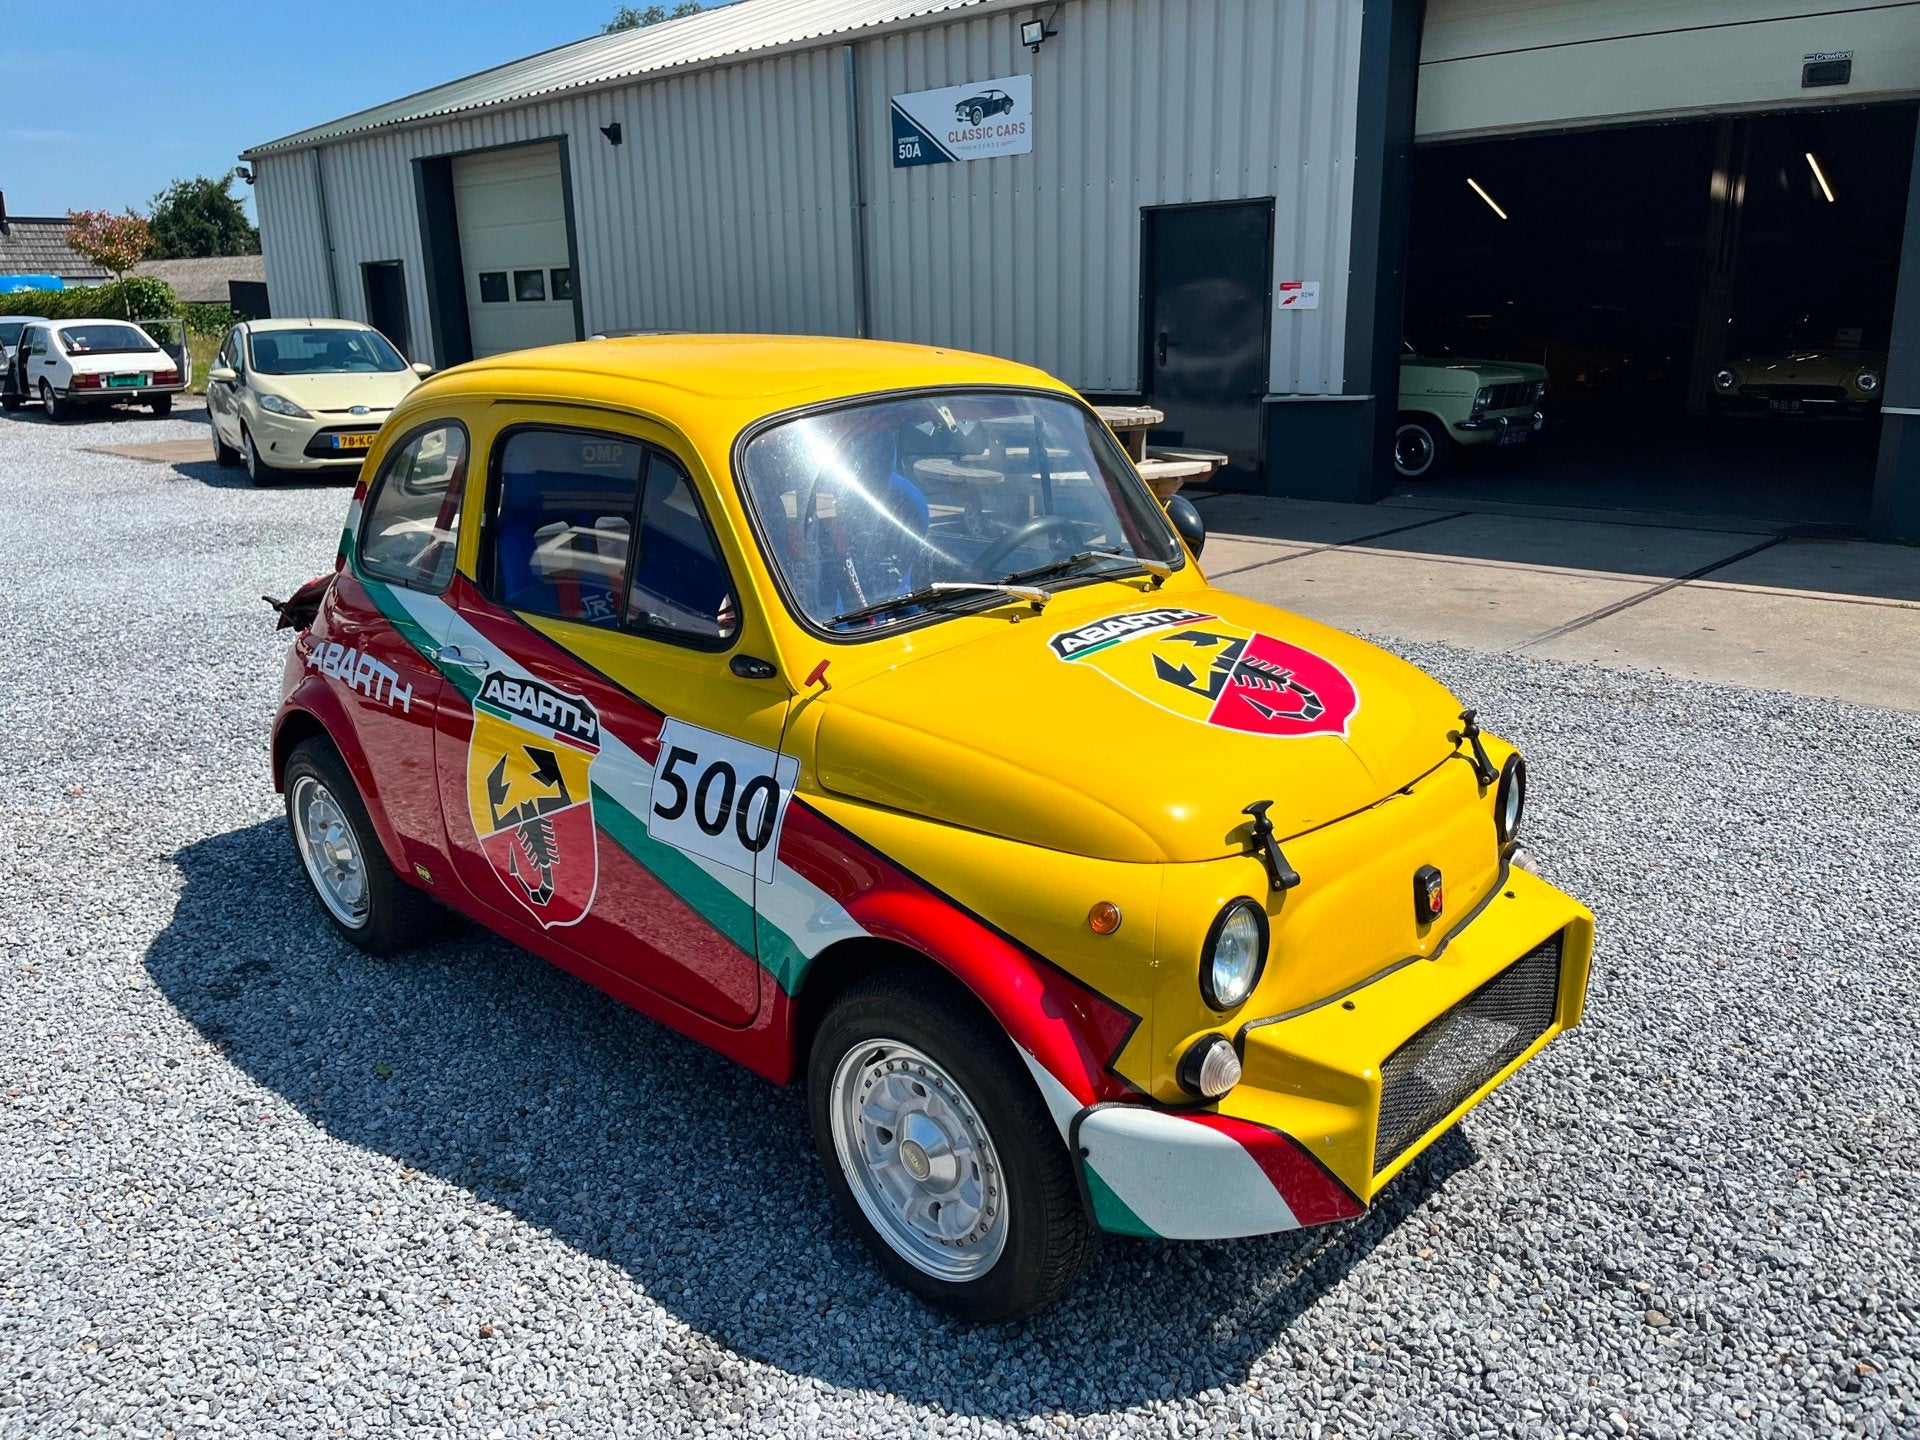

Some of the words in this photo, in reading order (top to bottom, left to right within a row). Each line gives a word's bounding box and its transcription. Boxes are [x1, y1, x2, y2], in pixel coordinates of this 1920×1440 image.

[948, 127, 993, 143] CLASSIC
[996, 122, 1026, 137] CARS
[898, 143, 922, 159] 50A
[340, 435, 377, 447] 78-KG
[581, 445, 623, 462] OMP
[1060, 610, 1200, 653] ABARTH
[306, 642, 413, 714] ABARTH
[484, 680, 596, 738] ABARTH
[653, 745, 780, 853] 500
